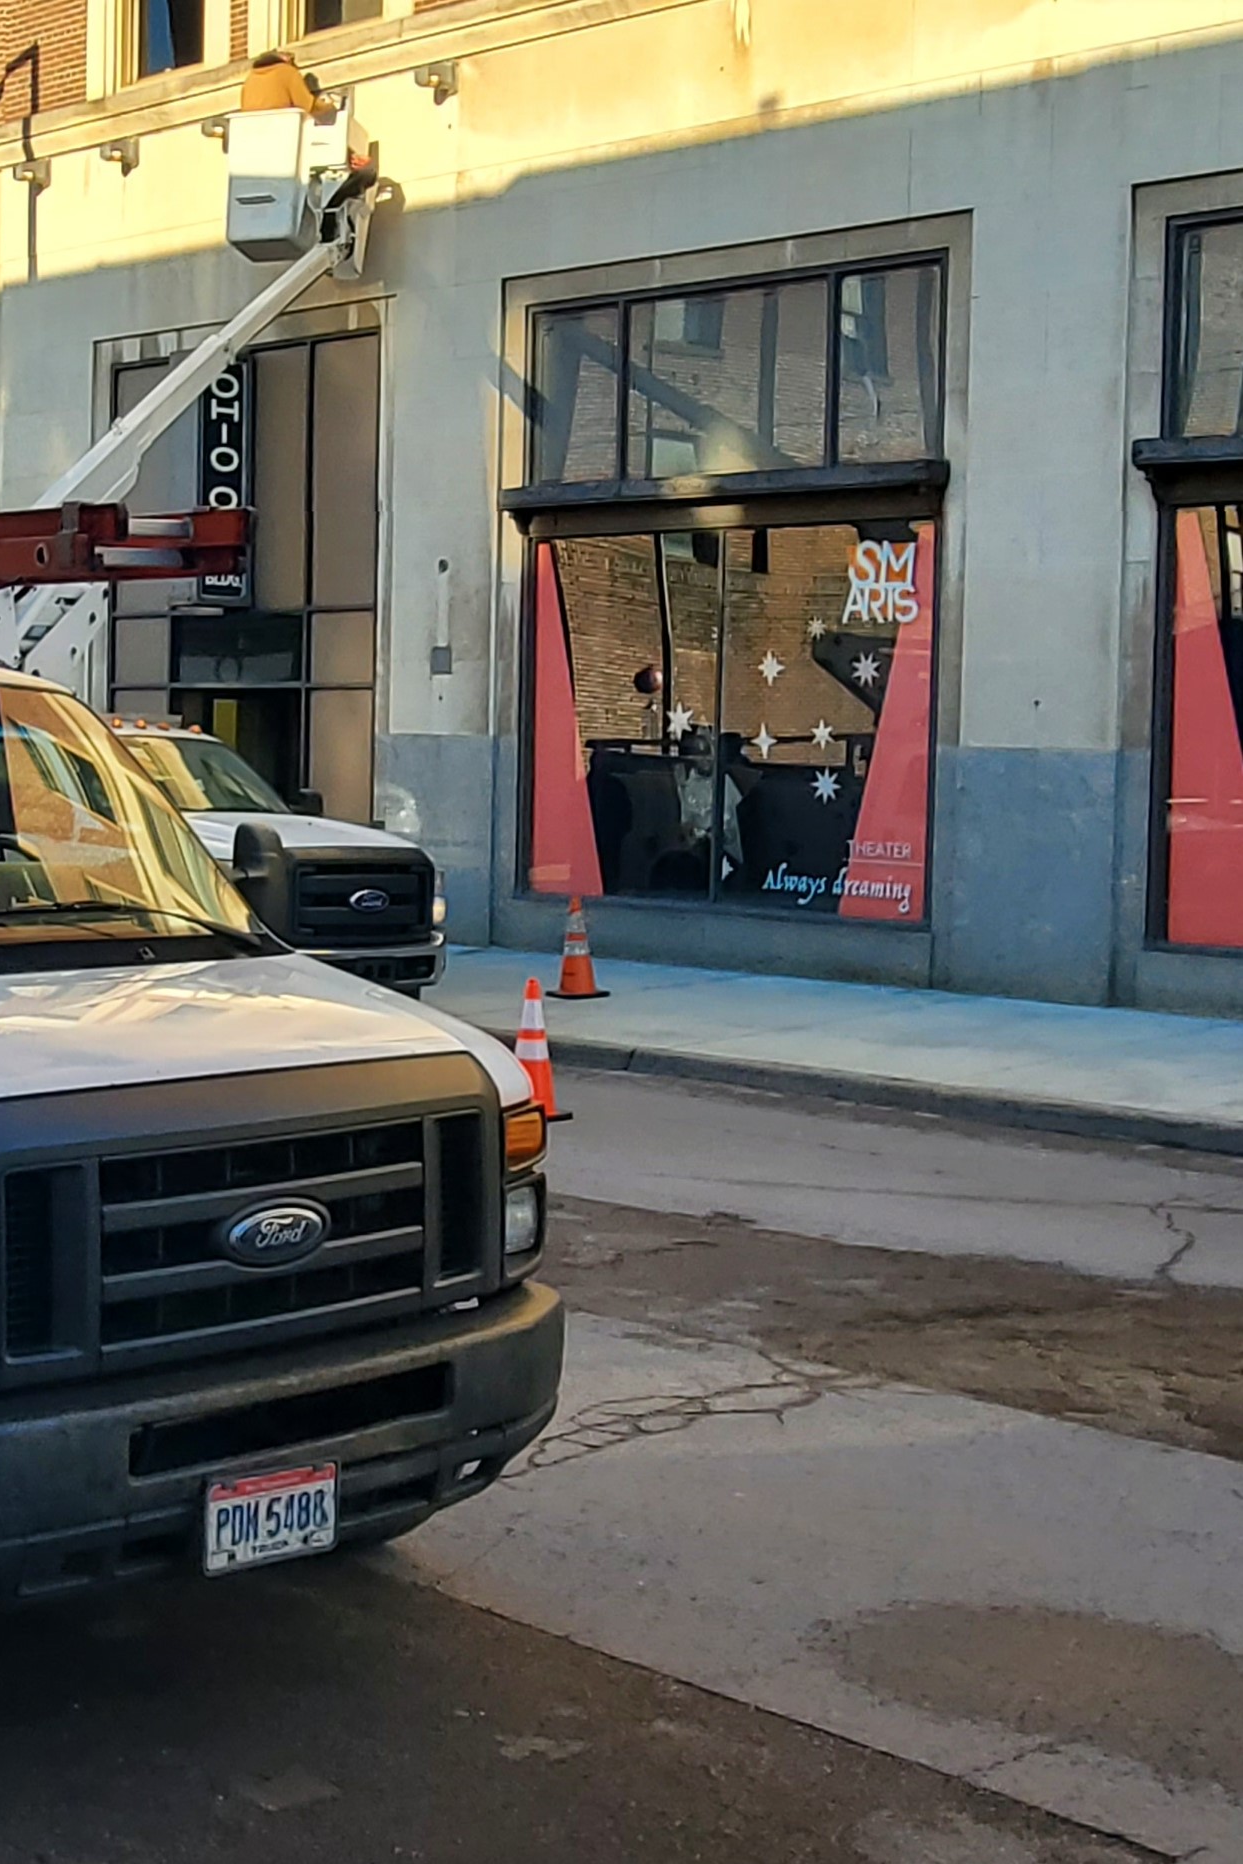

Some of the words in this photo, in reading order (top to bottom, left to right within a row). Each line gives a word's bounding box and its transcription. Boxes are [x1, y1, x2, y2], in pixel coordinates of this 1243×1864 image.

[848, 540, 917, 585] SM
[842, 584, 919, 624] ARTS
[846, 840, 911, 860] THEATER
[762, 862, 827, 905] Always
[832, 867, 911, 913] dreaming
[255, 1216, 309, 1248] Ford
